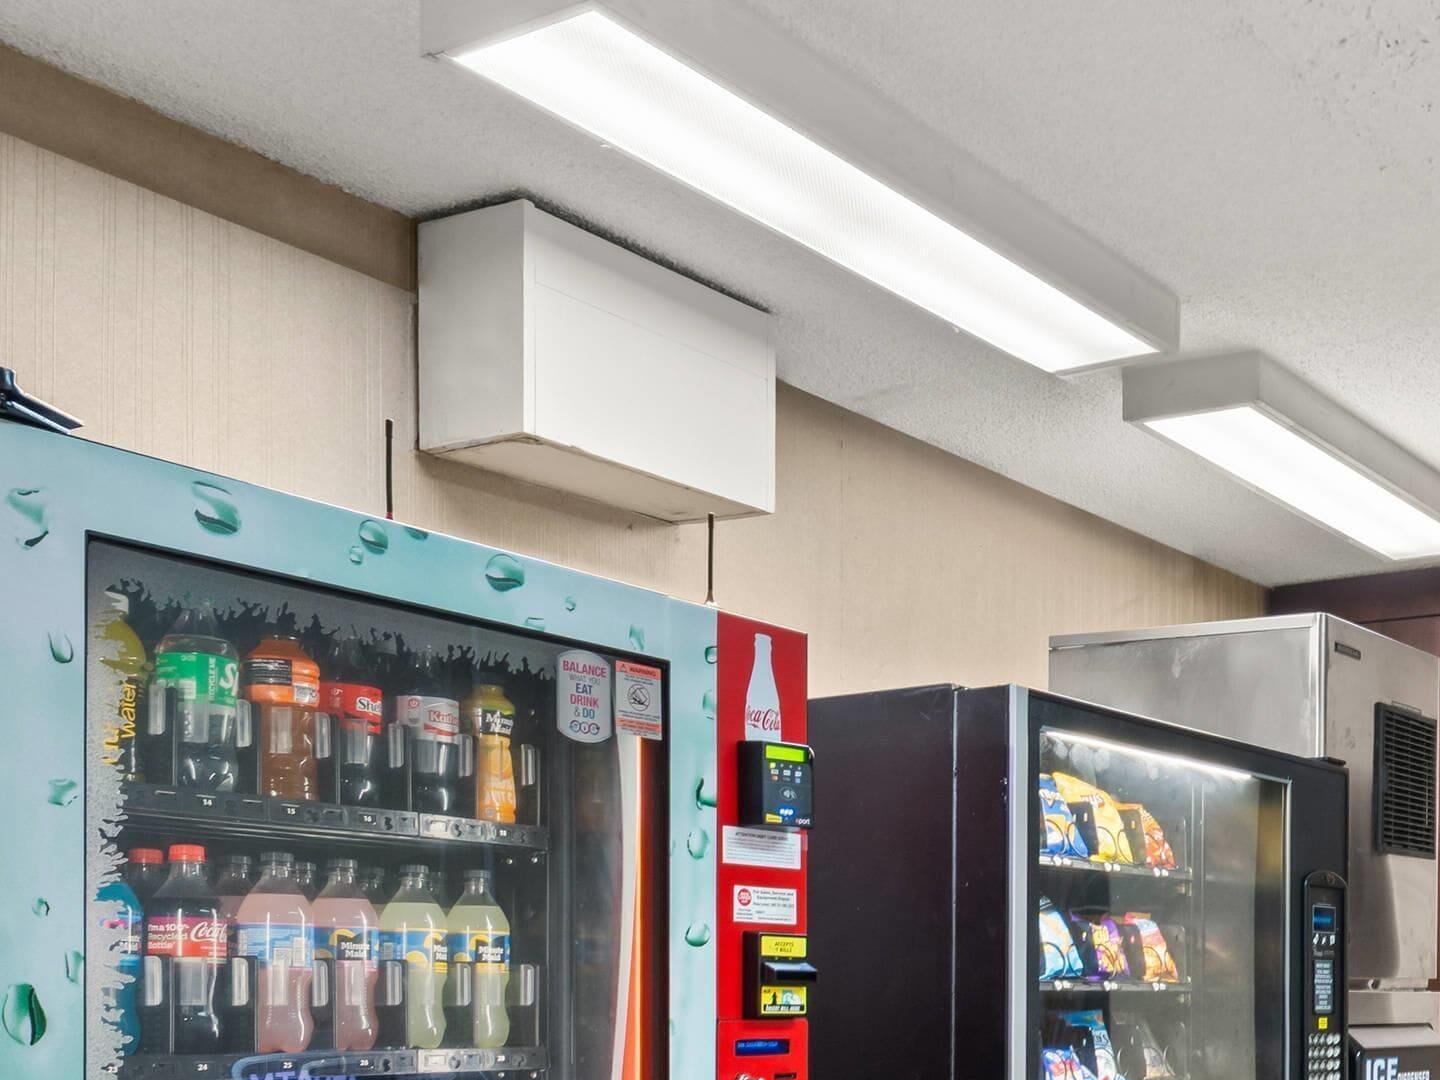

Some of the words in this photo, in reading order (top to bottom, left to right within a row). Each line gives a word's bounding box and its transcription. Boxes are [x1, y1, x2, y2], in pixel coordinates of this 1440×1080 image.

[563, 660, 607, 678] BALANCE
[575, 682, 592, 695] EAT
[569, 694, 599, 708] DRINK
[582, 707, 596, 719] DO
[746, 706, 780, 731] oca-Cola
[202, 798, 213, 807] 14
[283, 1061, 293, 1069] 25
